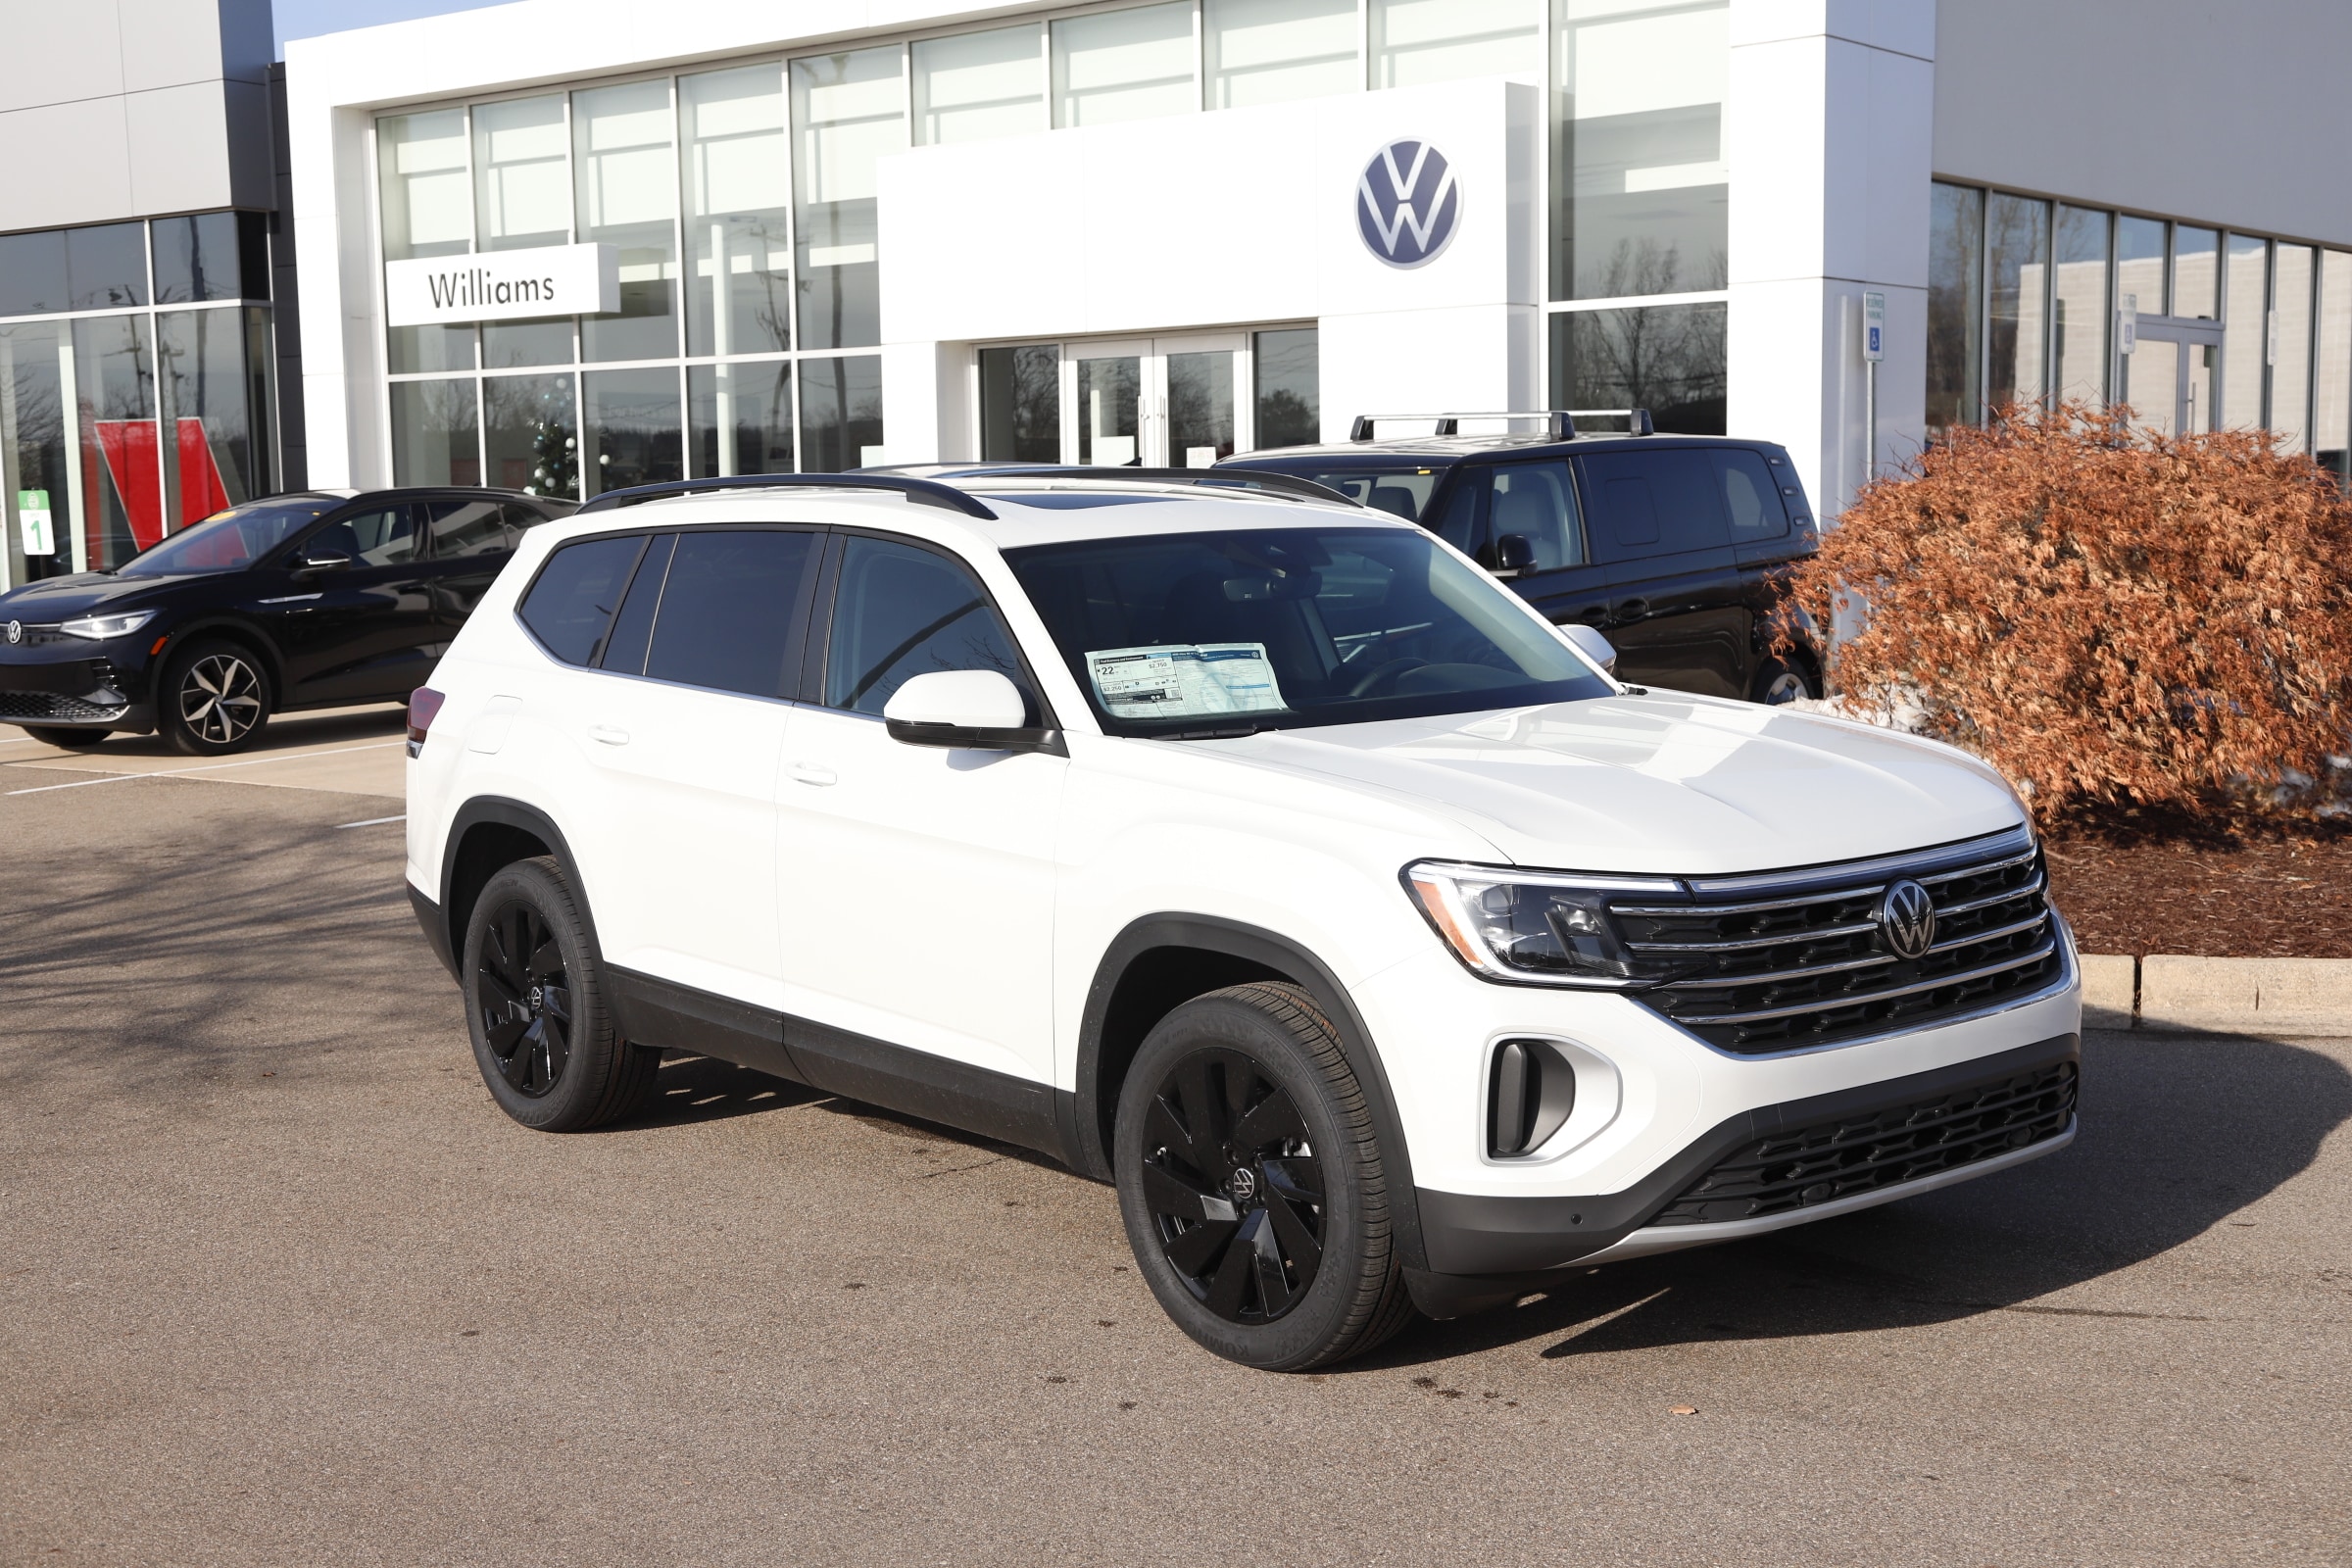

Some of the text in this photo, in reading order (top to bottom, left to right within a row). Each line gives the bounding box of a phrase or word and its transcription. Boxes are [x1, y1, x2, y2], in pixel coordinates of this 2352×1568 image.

[428, 268, 555, 309] Williams
[30, 519, 42, 551] 1
[1102, 666, 1115, 675] 22
